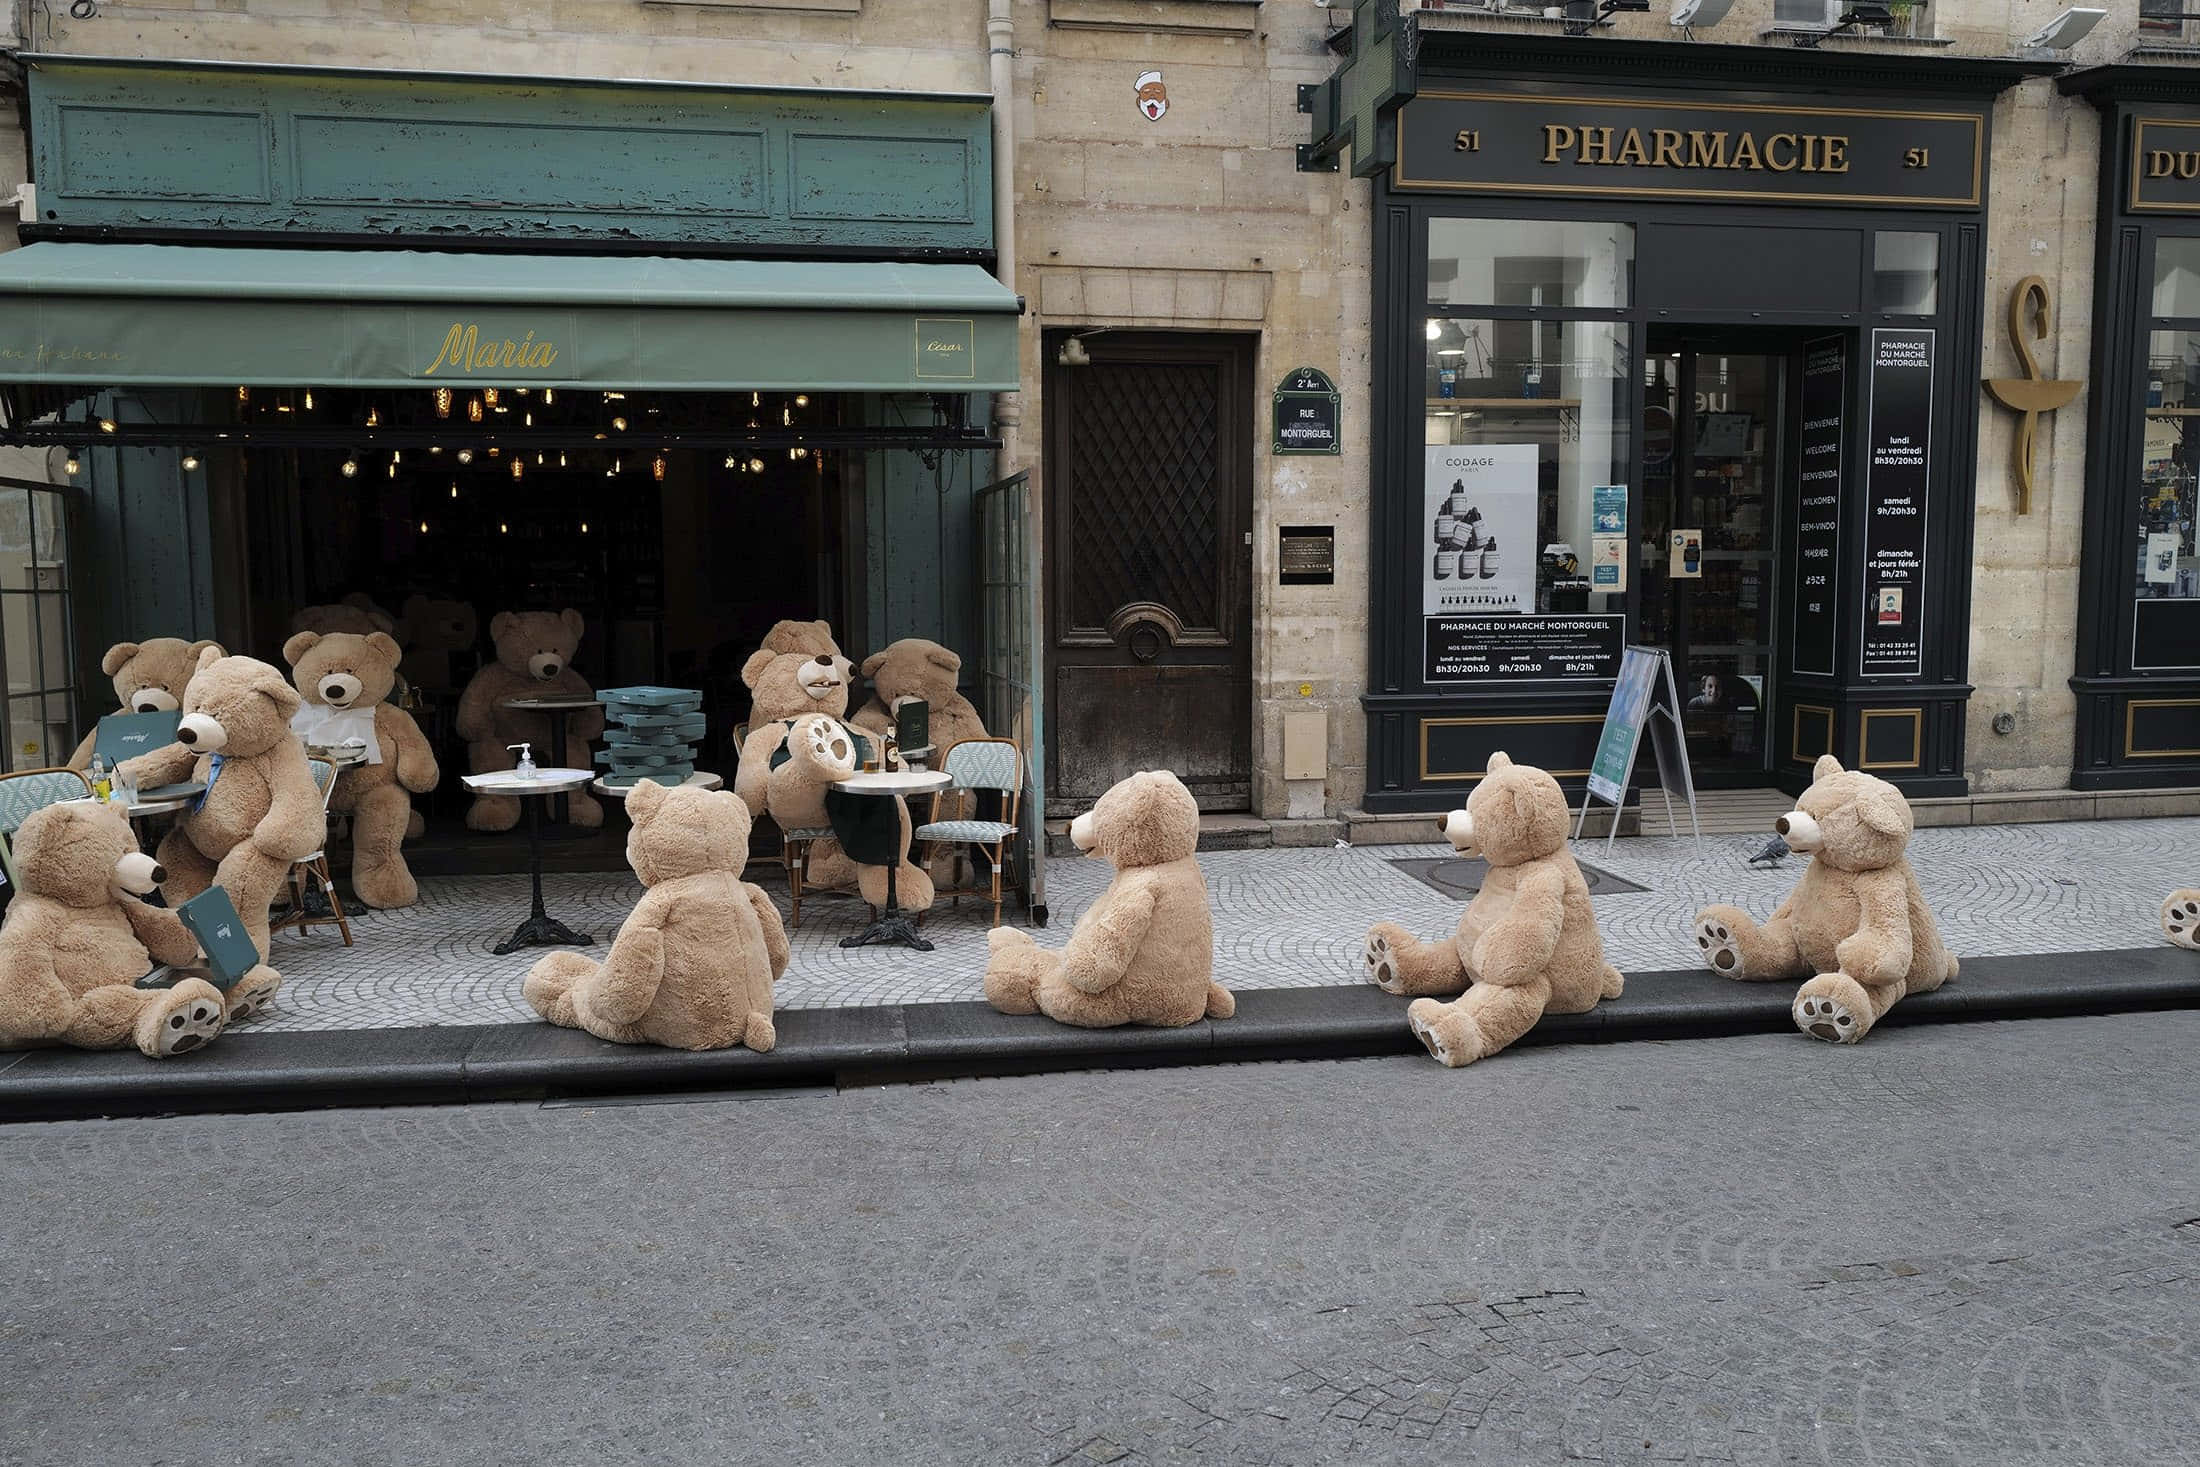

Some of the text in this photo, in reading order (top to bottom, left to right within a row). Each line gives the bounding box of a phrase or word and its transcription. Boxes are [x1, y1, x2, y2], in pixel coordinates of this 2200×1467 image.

[1455, 124, 1928, 172] 51 PHARMACIE 51
[2150, 150, 2200, 177] DU
[1881, 342, 1926, 350] PHARMACIE
[1893, 350, 1926, 358] MARCHÉ
[1876, 359, 1930, 367] MONTORGUEIL
[1300, 409, 1315, 418] RUE
[1804, 417, 1840, 430] BIENVENUE
[1281, 429, 1333, 438] MONTORGUEIL
[1890, 436, 1910, 444] lundi
[1805, 443, 1837, 455] WELCOME
[1888, 447, 1922, 455] vendredi
[1446, 458, 1494, 467] CODAGE
[1874, 457, 1923, 465] 8h30/20h30
[1884, 497, 1911, 505] samedi
[1877, 507, 1917, 515] 9h/20h30
[1877, 550, 1914, 558] dimanche
[1878, 560, 1897, 569] jours
[1881, 570, 1908, 578] 8h/21h
[1440, 620, 1610, 631] PHARMACIE DU MARCHÉ MONTORGUEIL
[1436, 665, 1490, 674] 8h30/20h30
[1498, 664, 1542, 673] 9h/20h30
[1565, 663, 1594, 672] 8h/21h
